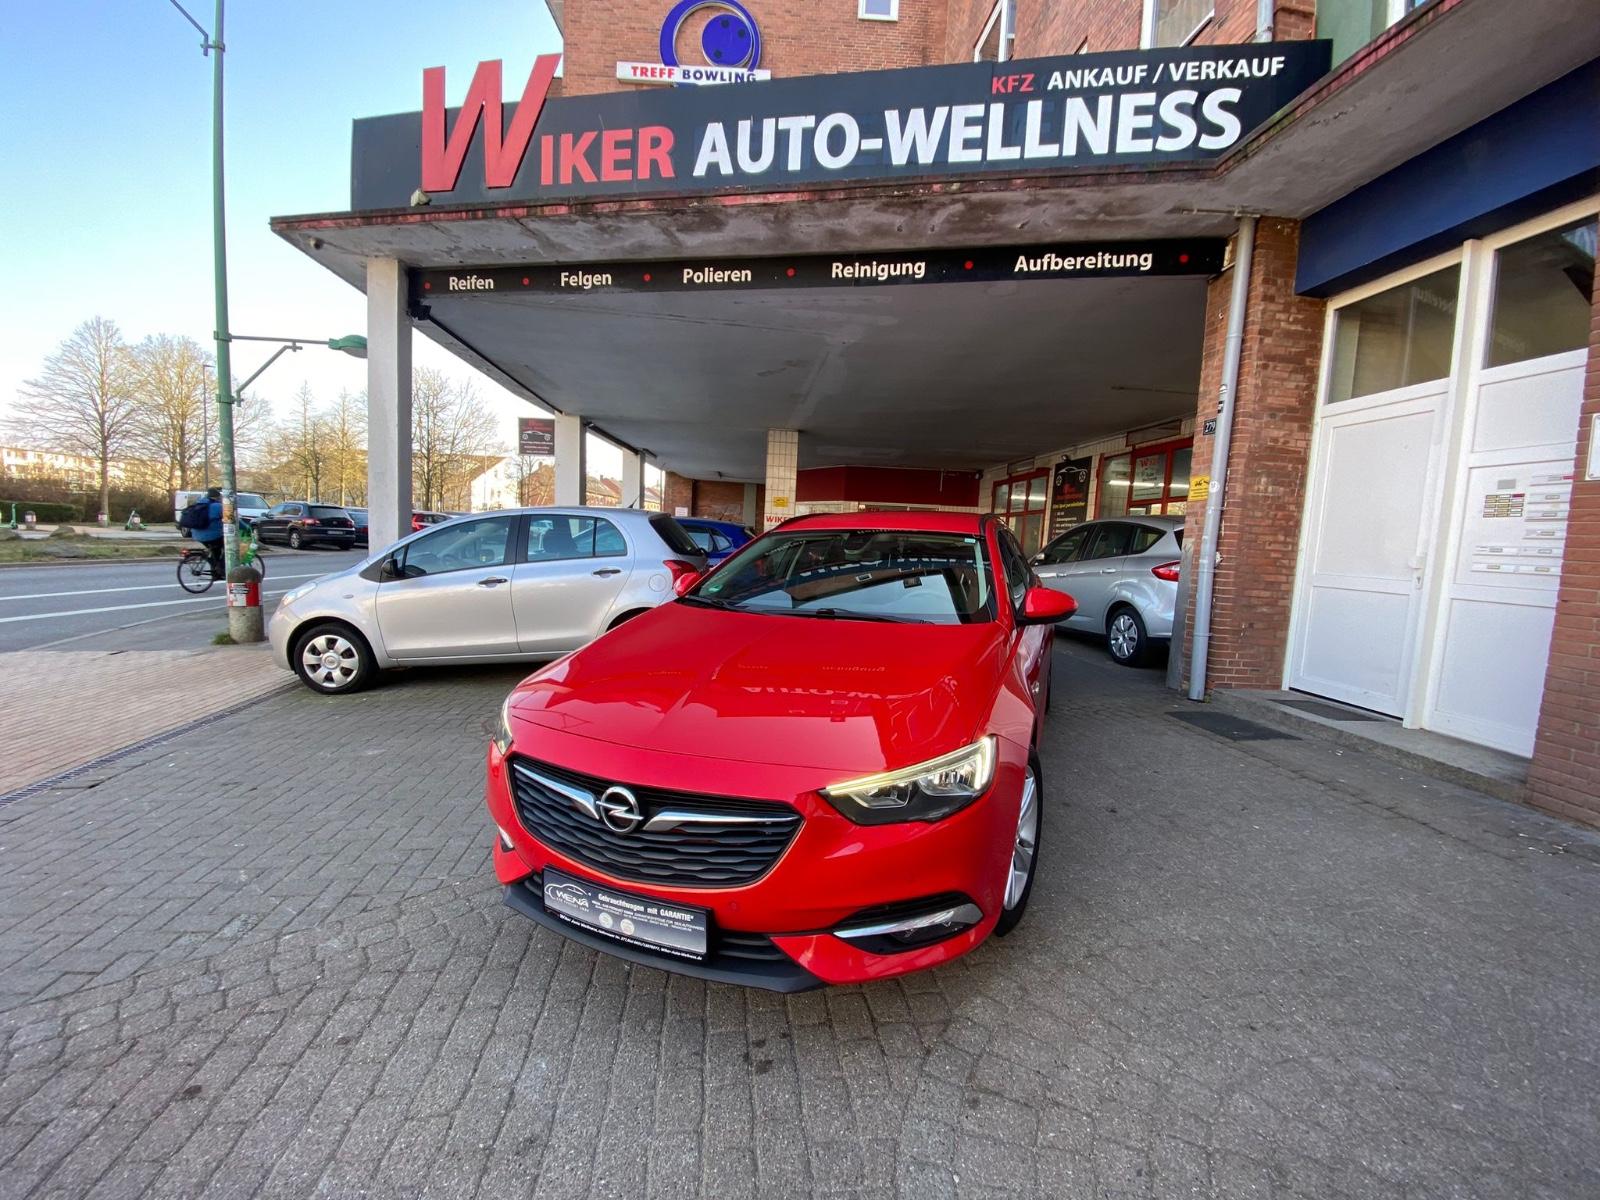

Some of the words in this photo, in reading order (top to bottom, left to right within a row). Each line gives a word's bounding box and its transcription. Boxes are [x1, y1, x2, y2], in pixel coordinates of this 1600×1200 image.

[631, 66, 675, 80] TREFF
[682, 69, 756, 84] BOWLING
[991, 73, 1035, 95] KFZ
[1047, 64, 1148, 91] ANKAUF
[1168, 55, 1286, 83] VERKAUF
[421, 53, 676, 193] WIKER
[692, 87, 1242, 178] AUTO-WELLNESS
[831, 260, 927, 282] Reinigung
[1014, 252, 1154, 274] Aufbereitung
[448, 275, 495, 292] Reifen
[560, 270, 612, 289] Felgen
[682, 266, 753, 284] Polieren
[556, 890, 589, 908] WENA
[598, 893, 645, 912] Gebrauchtwagen
[647, 907, 658, 915] mit
